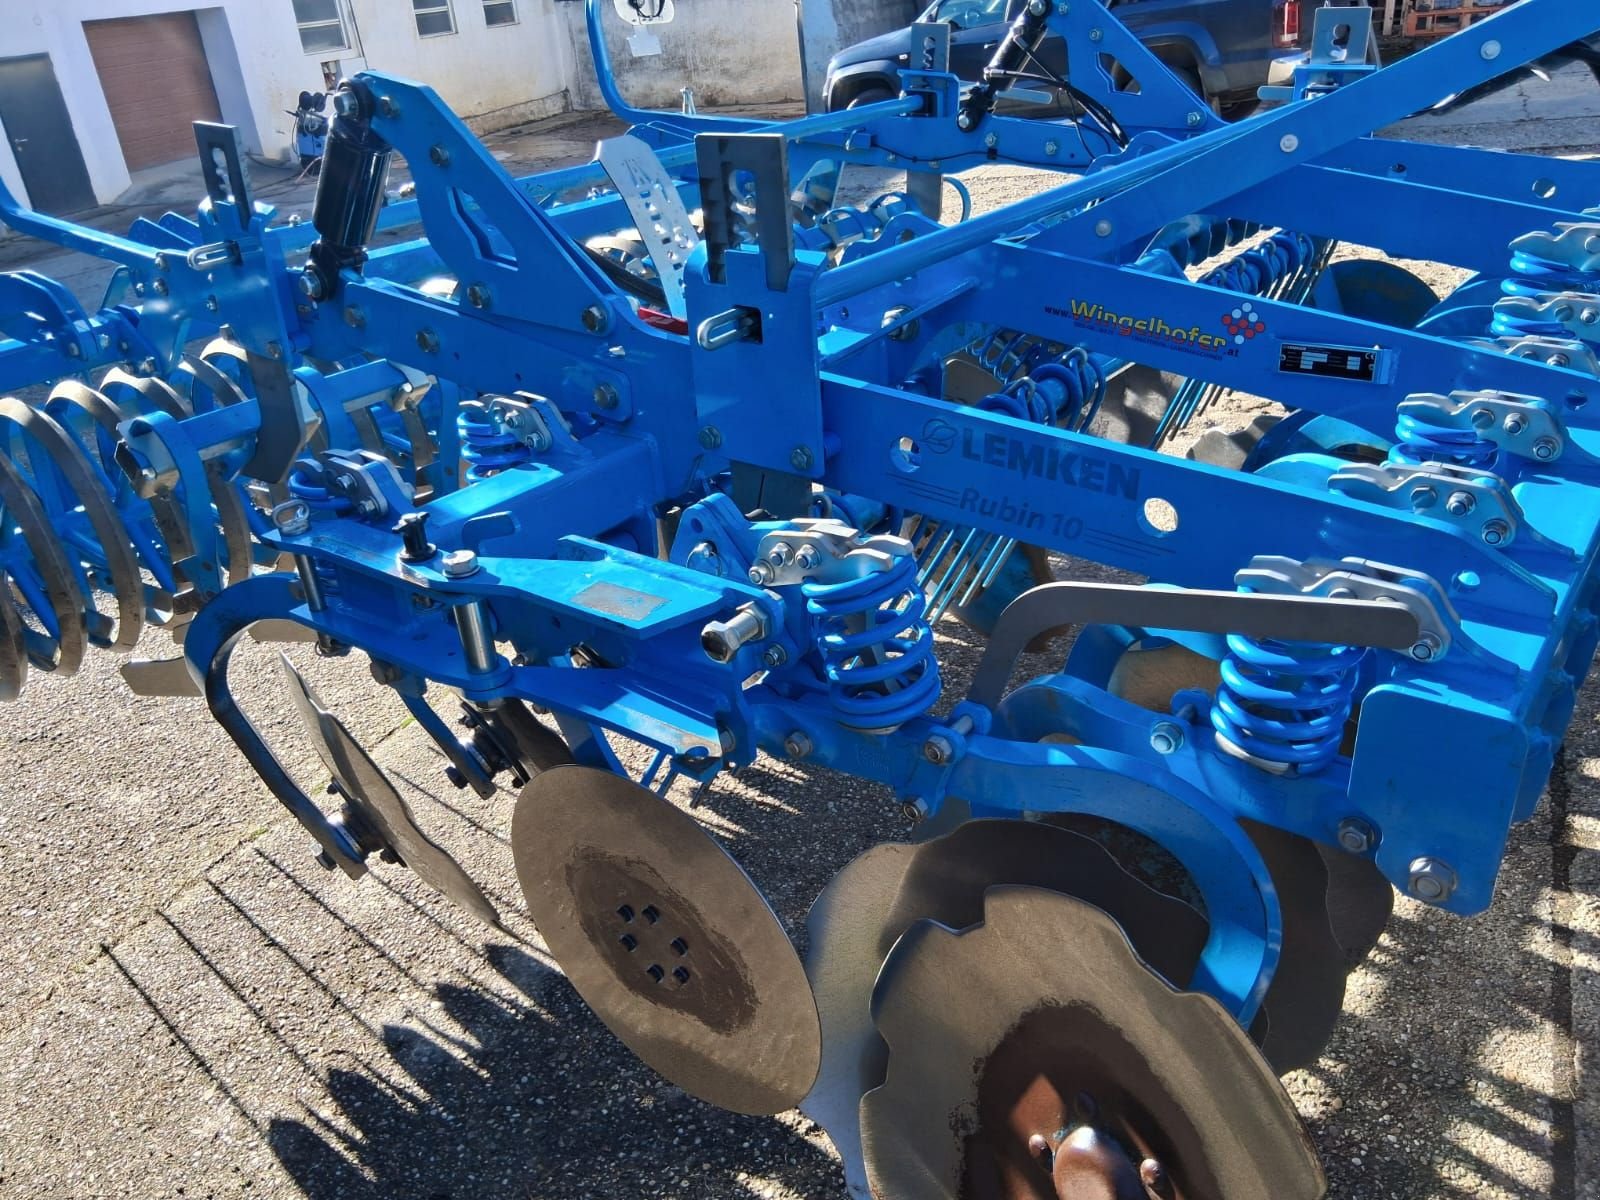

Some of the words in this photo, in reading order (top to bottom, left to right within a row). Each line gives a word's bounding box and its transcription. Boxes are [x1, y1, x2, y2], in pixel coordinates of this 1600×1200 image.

[961, 426, 1142, 502] LEMKEN
[959, 487, 1046, 530] Rubin
[1050, 512, 1084, 541] 10
